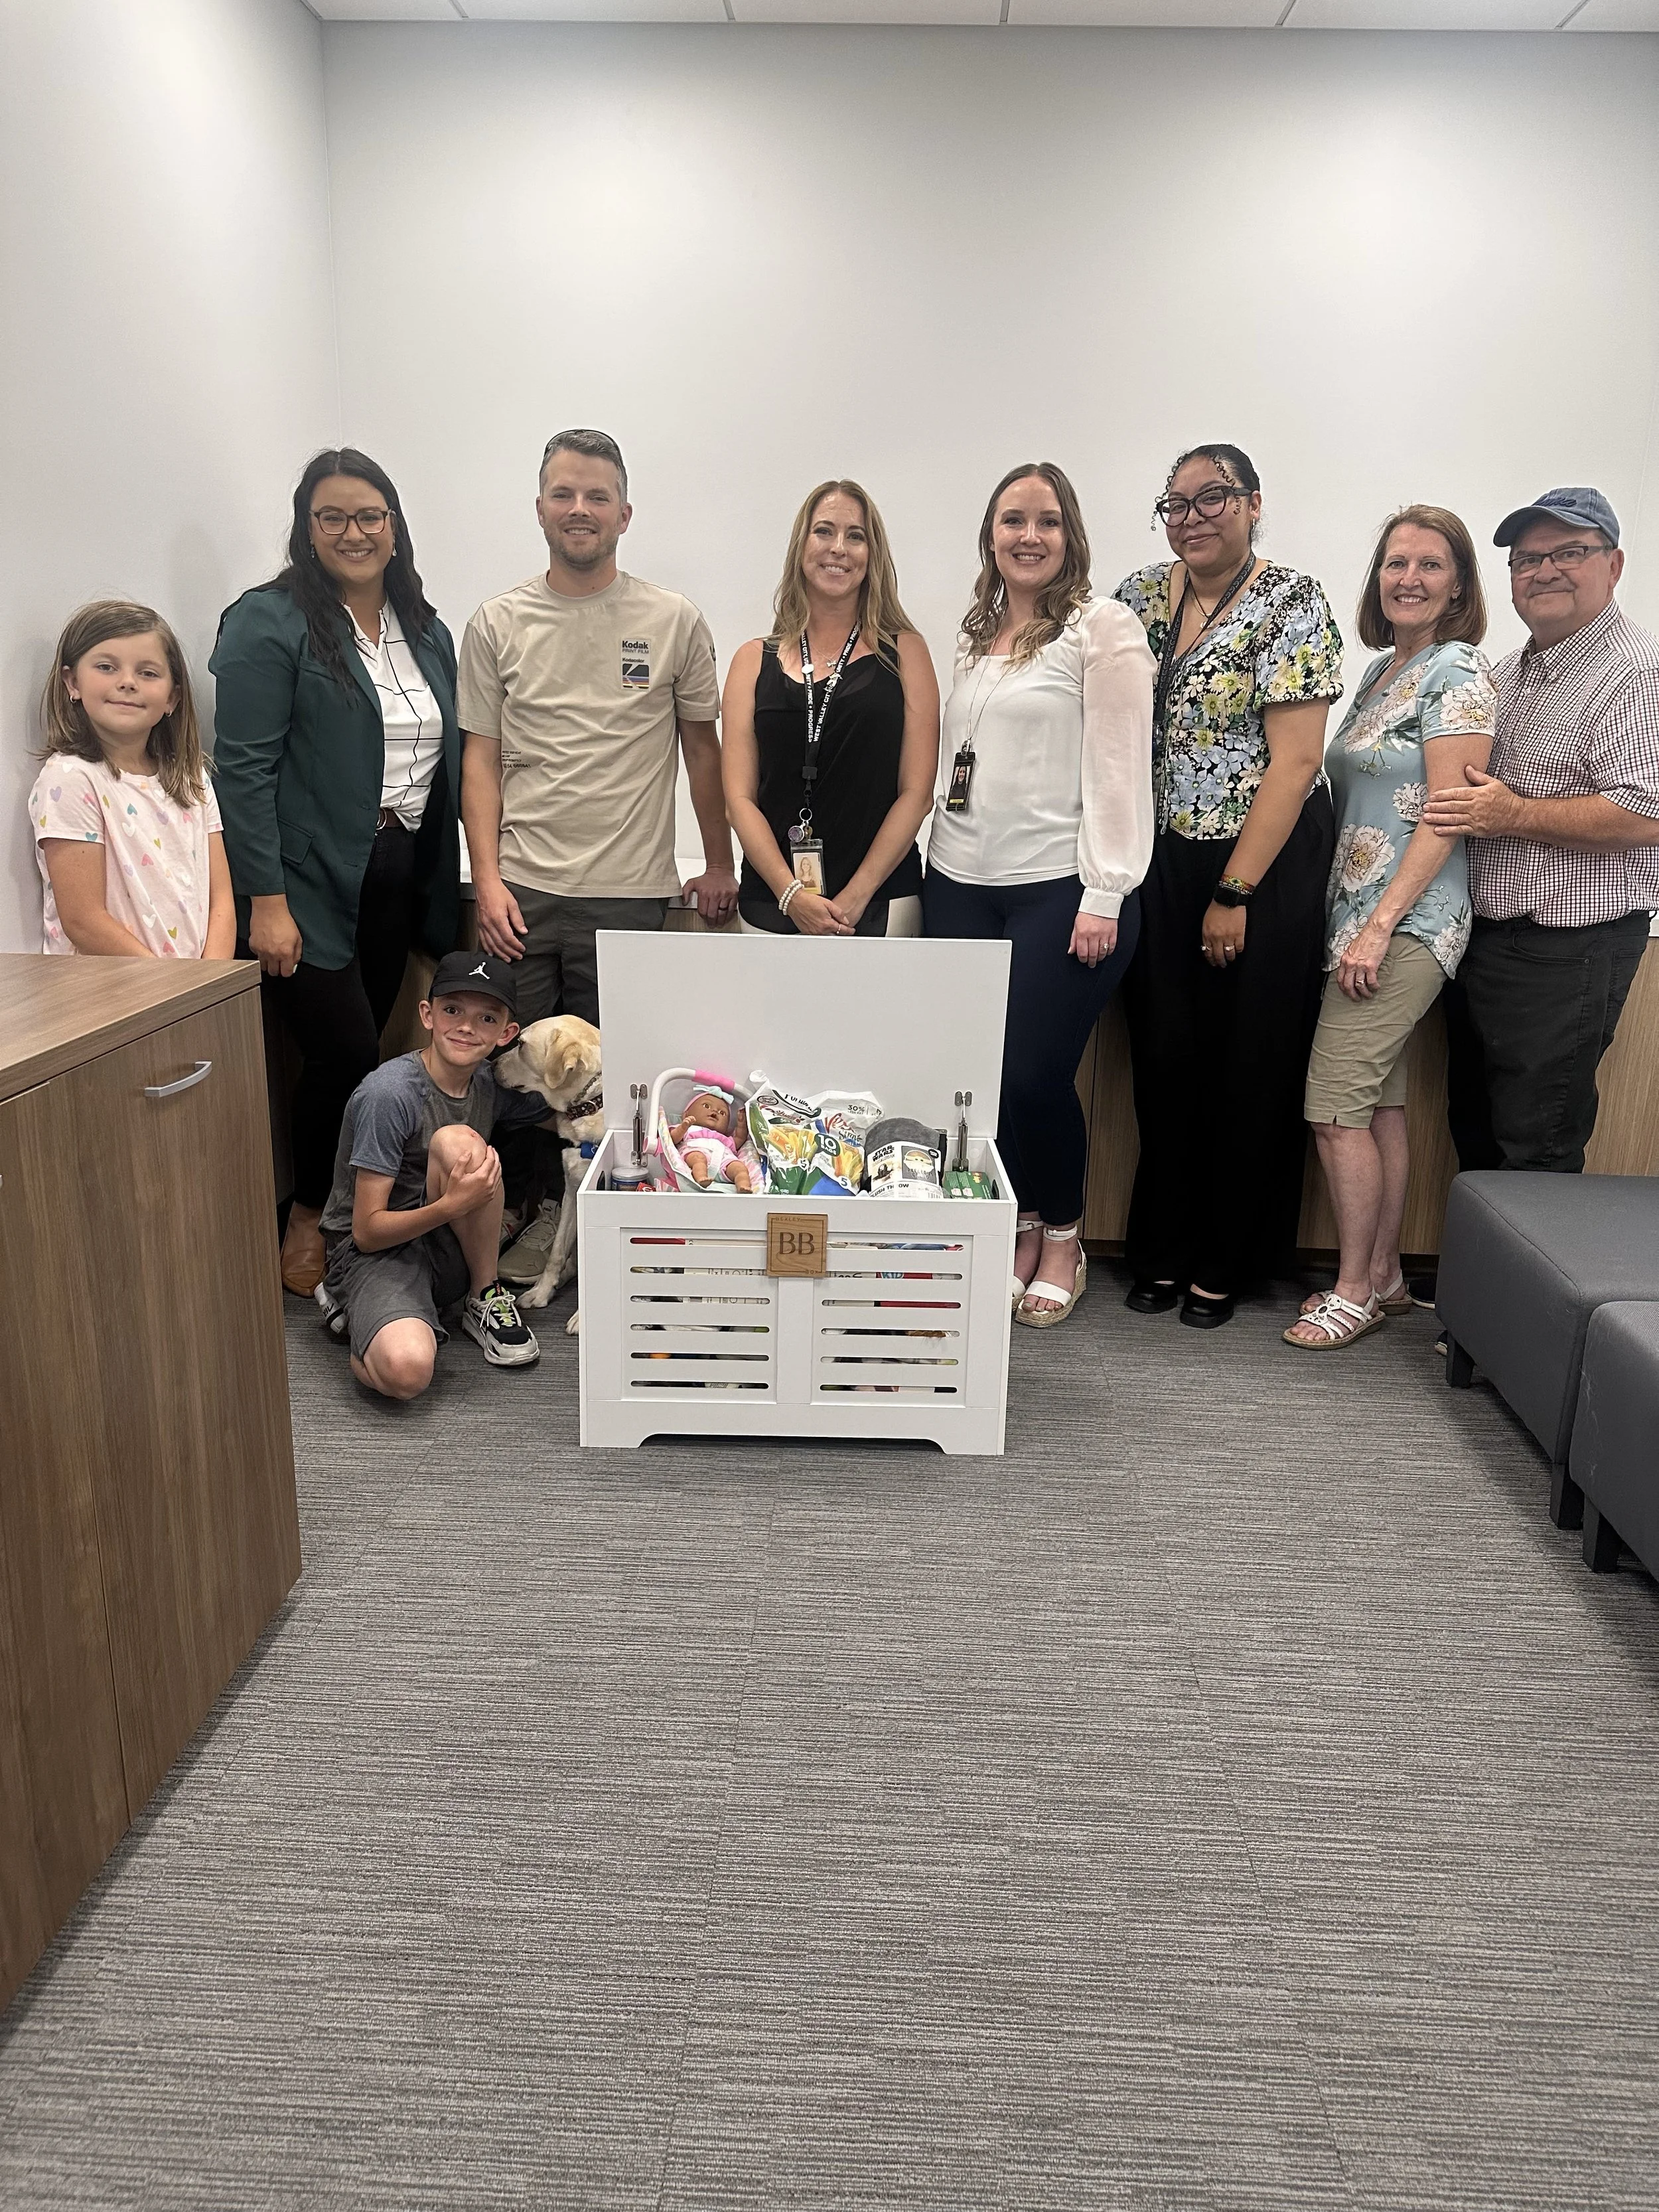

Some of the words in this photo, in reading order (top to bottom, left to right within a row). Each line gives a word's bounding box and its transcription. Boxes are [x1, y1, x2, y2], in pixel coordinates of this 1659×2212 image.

[622, 640, 648, 649] Kodak
[843, 642, 852, 656] PRIDE
[813, 725, 822, 742] WEST
[818, 703, 827, 724] VALLEY
[818, 1134, 836, 1149] 10
[820, 1144, 837, 1155] BAGS
[873, 1145, 894, 1158] STAR
[873, 1148, 894, 1161] WARS
[841, 1178, 848, 1187] 5
[779, 1232, 815, 1255] BB
